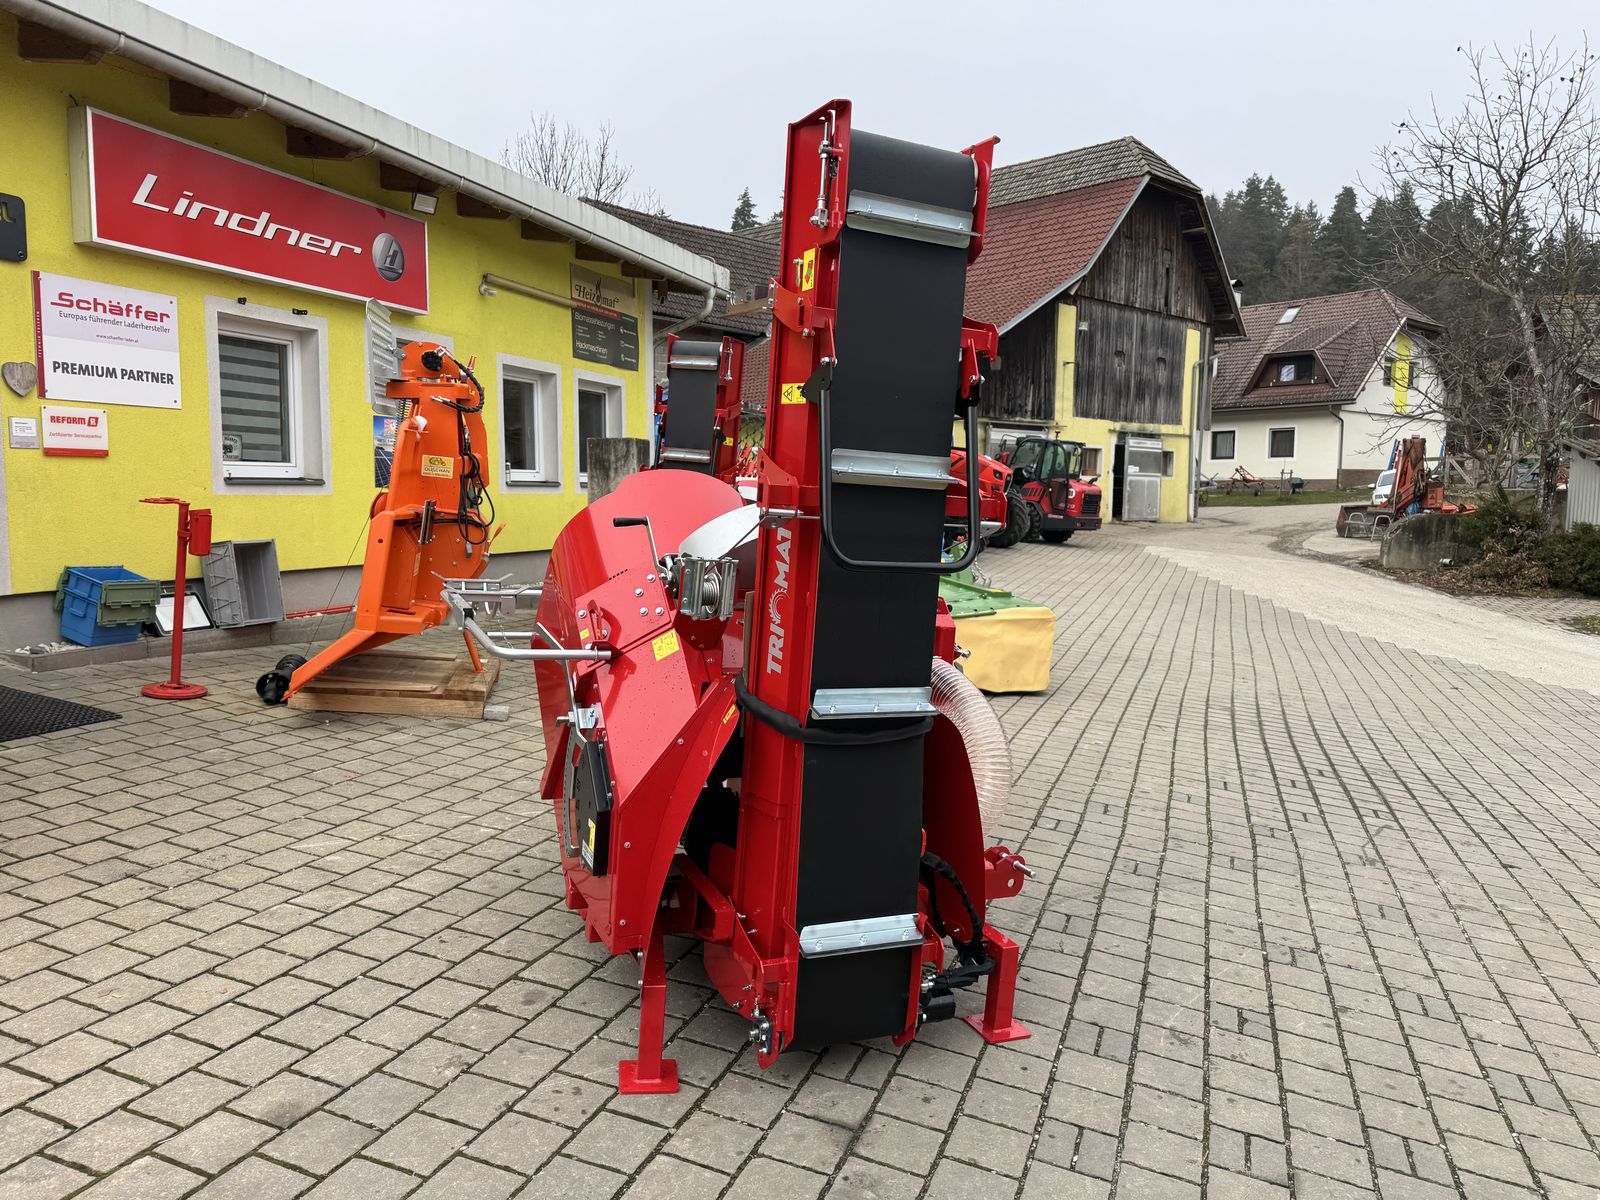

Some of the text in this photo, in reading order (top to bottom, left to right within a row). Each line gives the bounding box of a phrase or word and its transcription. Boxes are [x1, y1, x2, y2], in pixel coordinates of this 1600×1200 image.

[132, 173, 362, 257] Lindner
[50, 291, 170, 323] Schäffer
[59, 310, 170, 334] Europas führender Laderhersteller
[52, 360, 174, 385] PREMIUM PARTNER
[50, 415, 86, 425] REFORM
